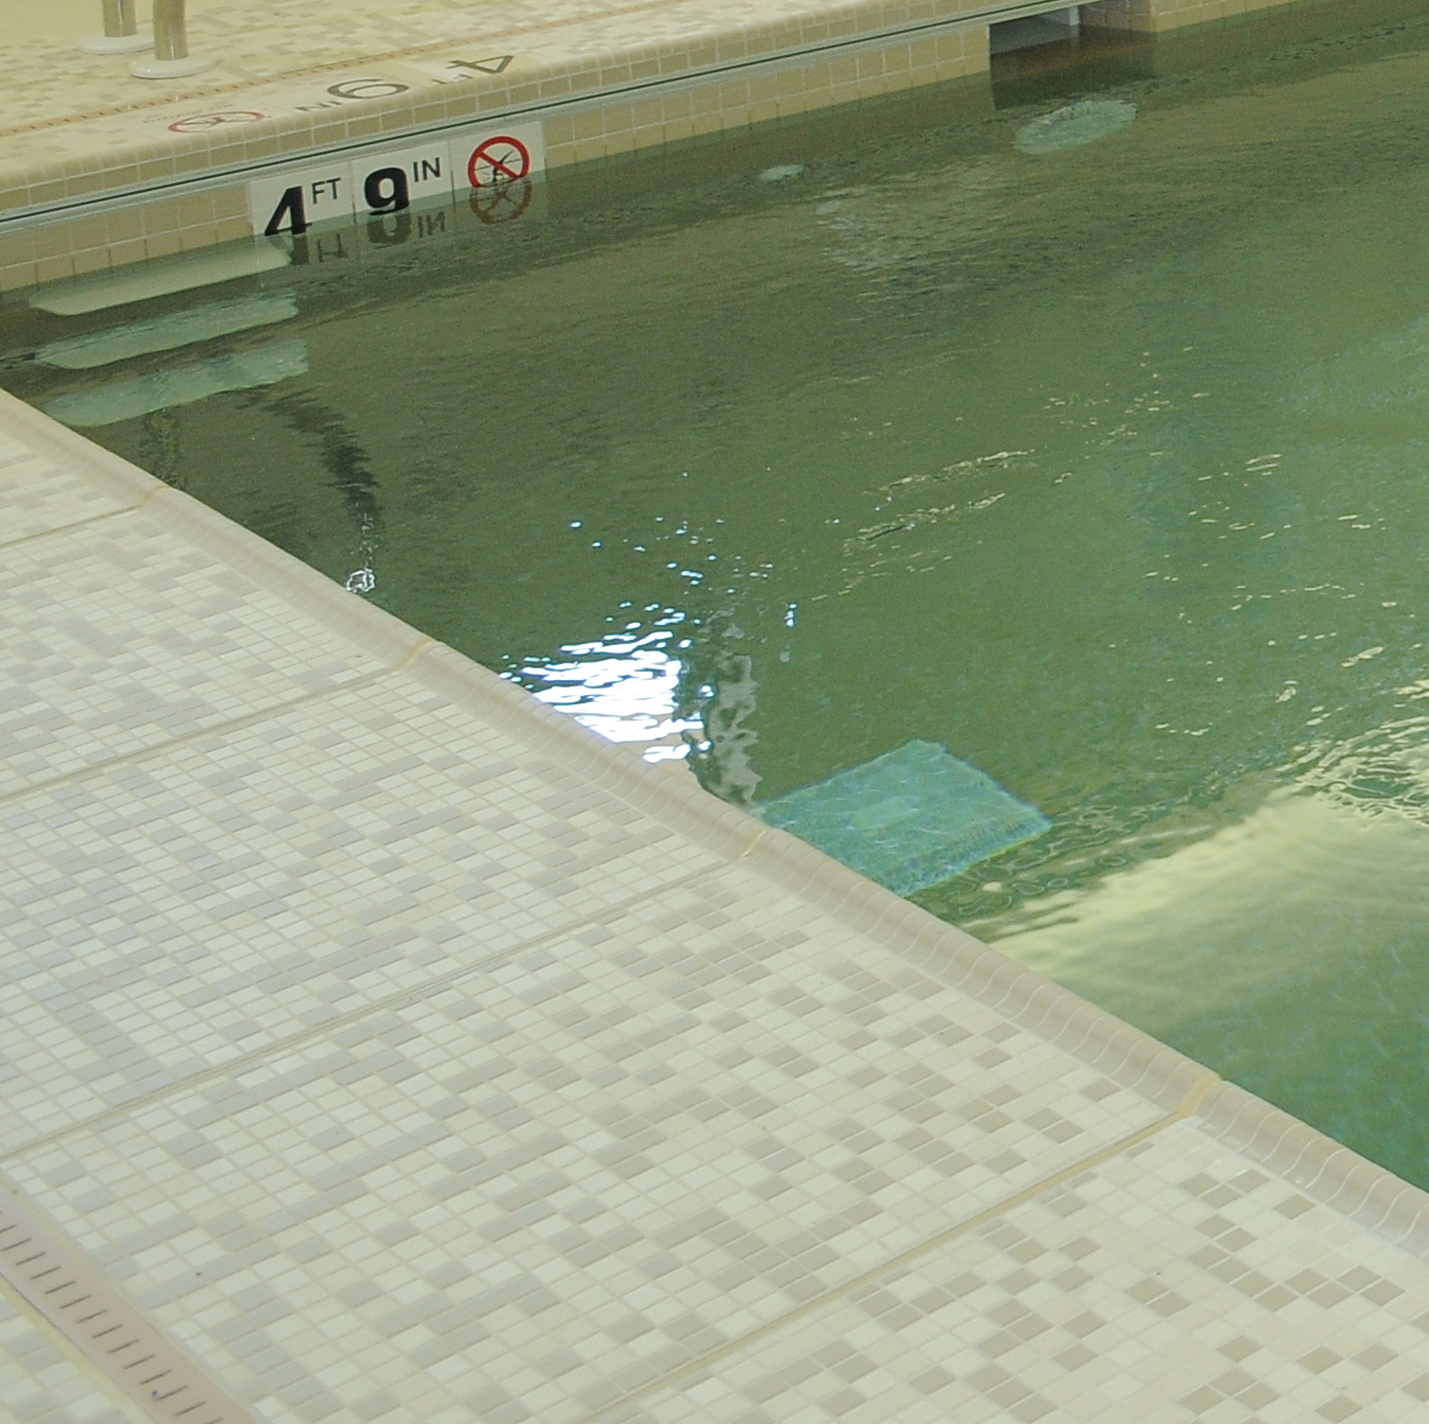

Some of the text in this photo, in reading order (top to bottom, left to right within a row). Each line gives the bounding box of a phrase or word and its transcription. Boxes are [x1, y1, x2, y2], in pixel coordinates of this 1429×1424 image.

[445, 55, 514, 74] 4
[264, 157, 441, 236] 4 FT 9 IN
